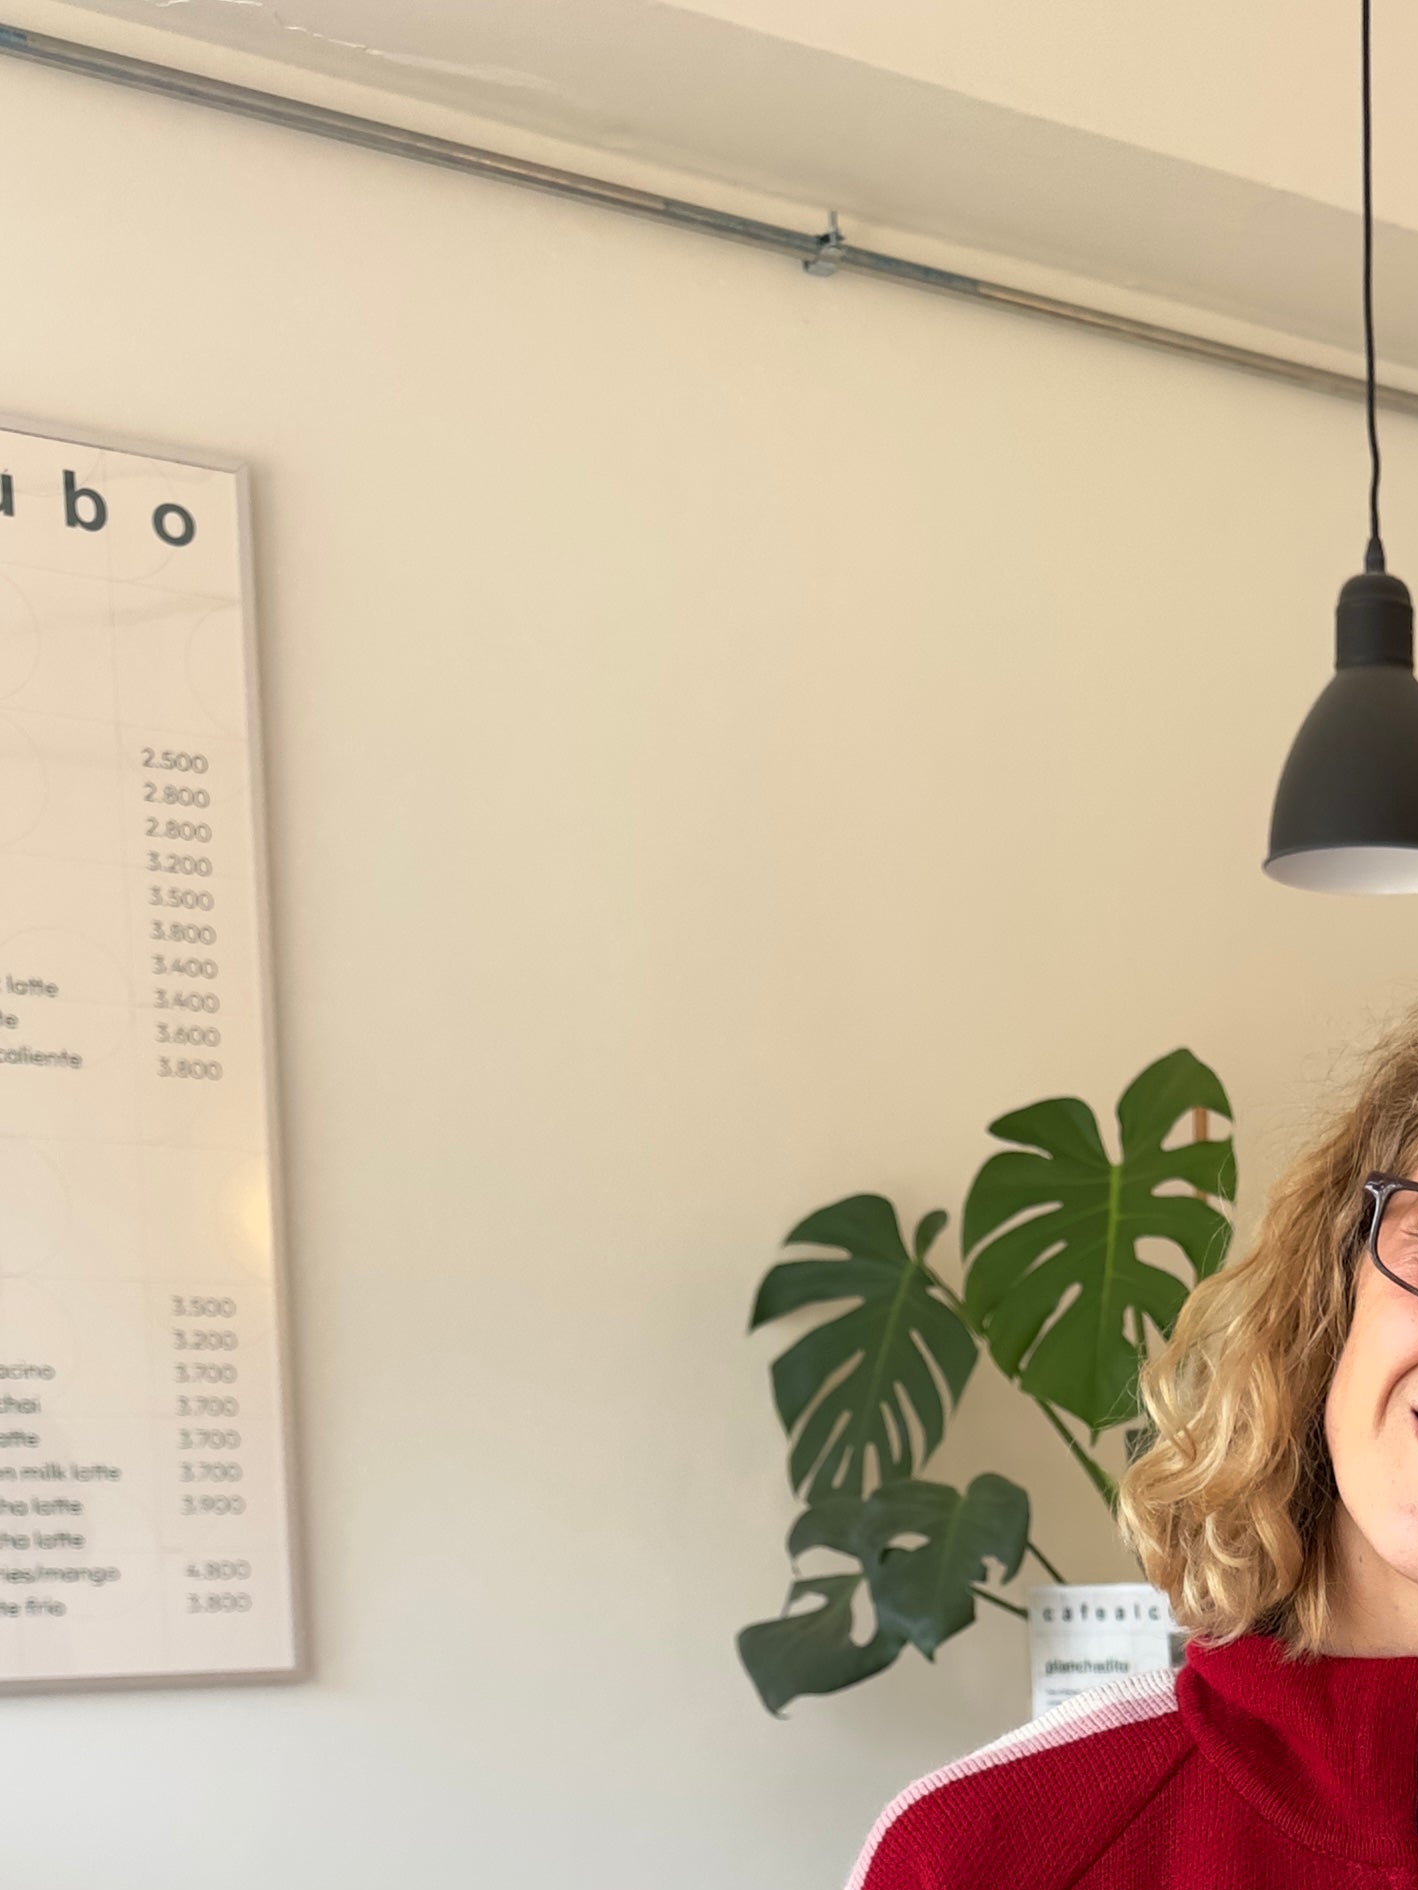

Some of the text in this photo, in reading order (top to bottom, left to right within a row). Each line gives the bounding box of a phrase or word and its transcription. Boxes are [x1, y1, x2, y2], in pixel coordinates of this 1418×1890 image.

[142, 747, 208, 774] 2.500
[144, 781, 210, 808] 2.800
[146, 817, 212, 843] 2.800
[147, 851, 213, 877] 3.200
[149, 885, 214, 911] 3.500
[6, 974, 59, 998] latte
